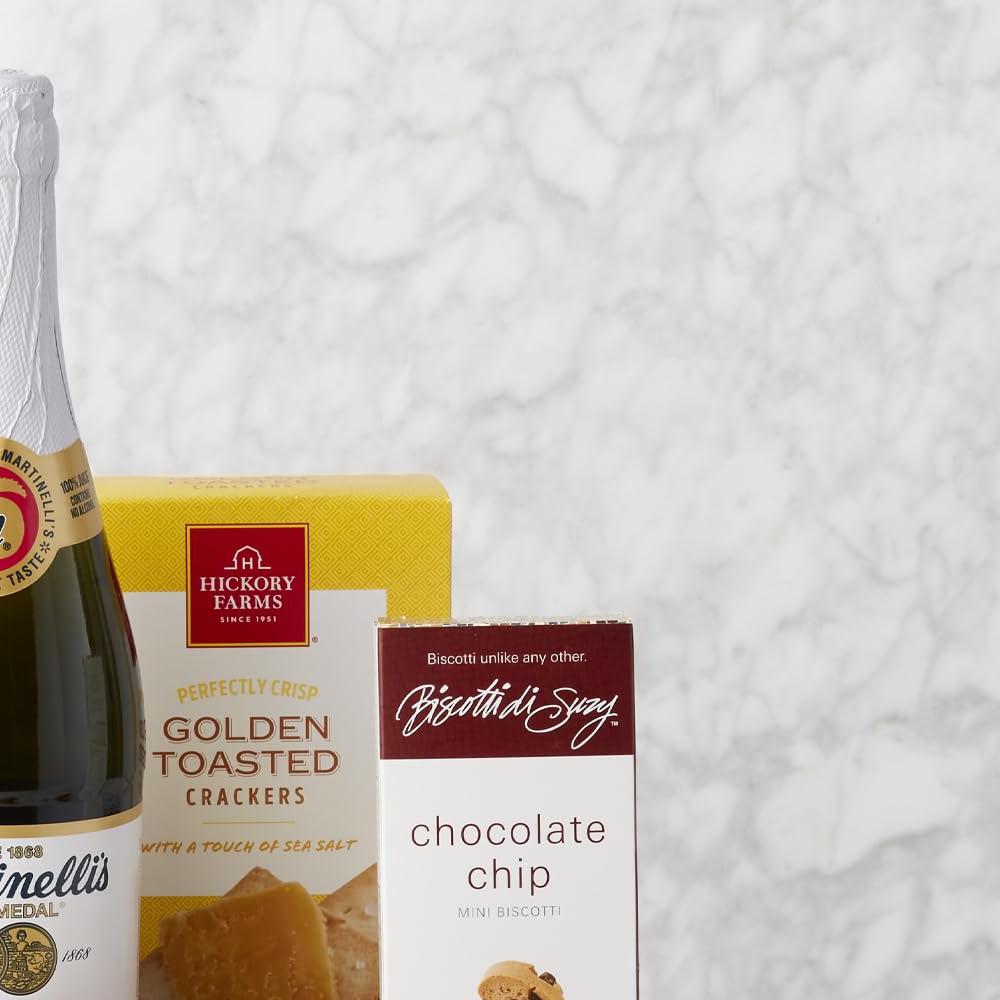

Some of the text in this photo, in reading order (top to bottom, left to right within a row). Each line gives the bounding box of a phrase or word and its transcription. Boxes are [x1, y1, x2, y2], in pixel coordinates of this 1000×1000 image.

[0, 448, 56, 539] MARTINELLI'S
[6, 553, 46, 587] TASTE
[200, 575, 296, 592] HICKORY
[213, 594, 283, 610] FARMS
[255, 615, 277, 623] 1951
[427, 651, 587, 666] Biscotti unlike any other.
[177, 677, 319, 704] PERFECTLY CRISP
[396, 678, 619, 750] Biscotti di Suzy
[163, 715, 331, 743] GOLDEN
[152, 749, 341, 777] TOASTED
[186, 786, 305, 806] CRACKERS
[411, 813, 606, 847] chocolate
[7, 844, 44, 859] 1868
[141, 839, 358, 853] WITH A TOUCH OF SEA SALT
[468, 858, 551, 896] chip
[458, 905, 562, 919] MINI BISCOTTI
[62, 946, 92, 963] 1868
